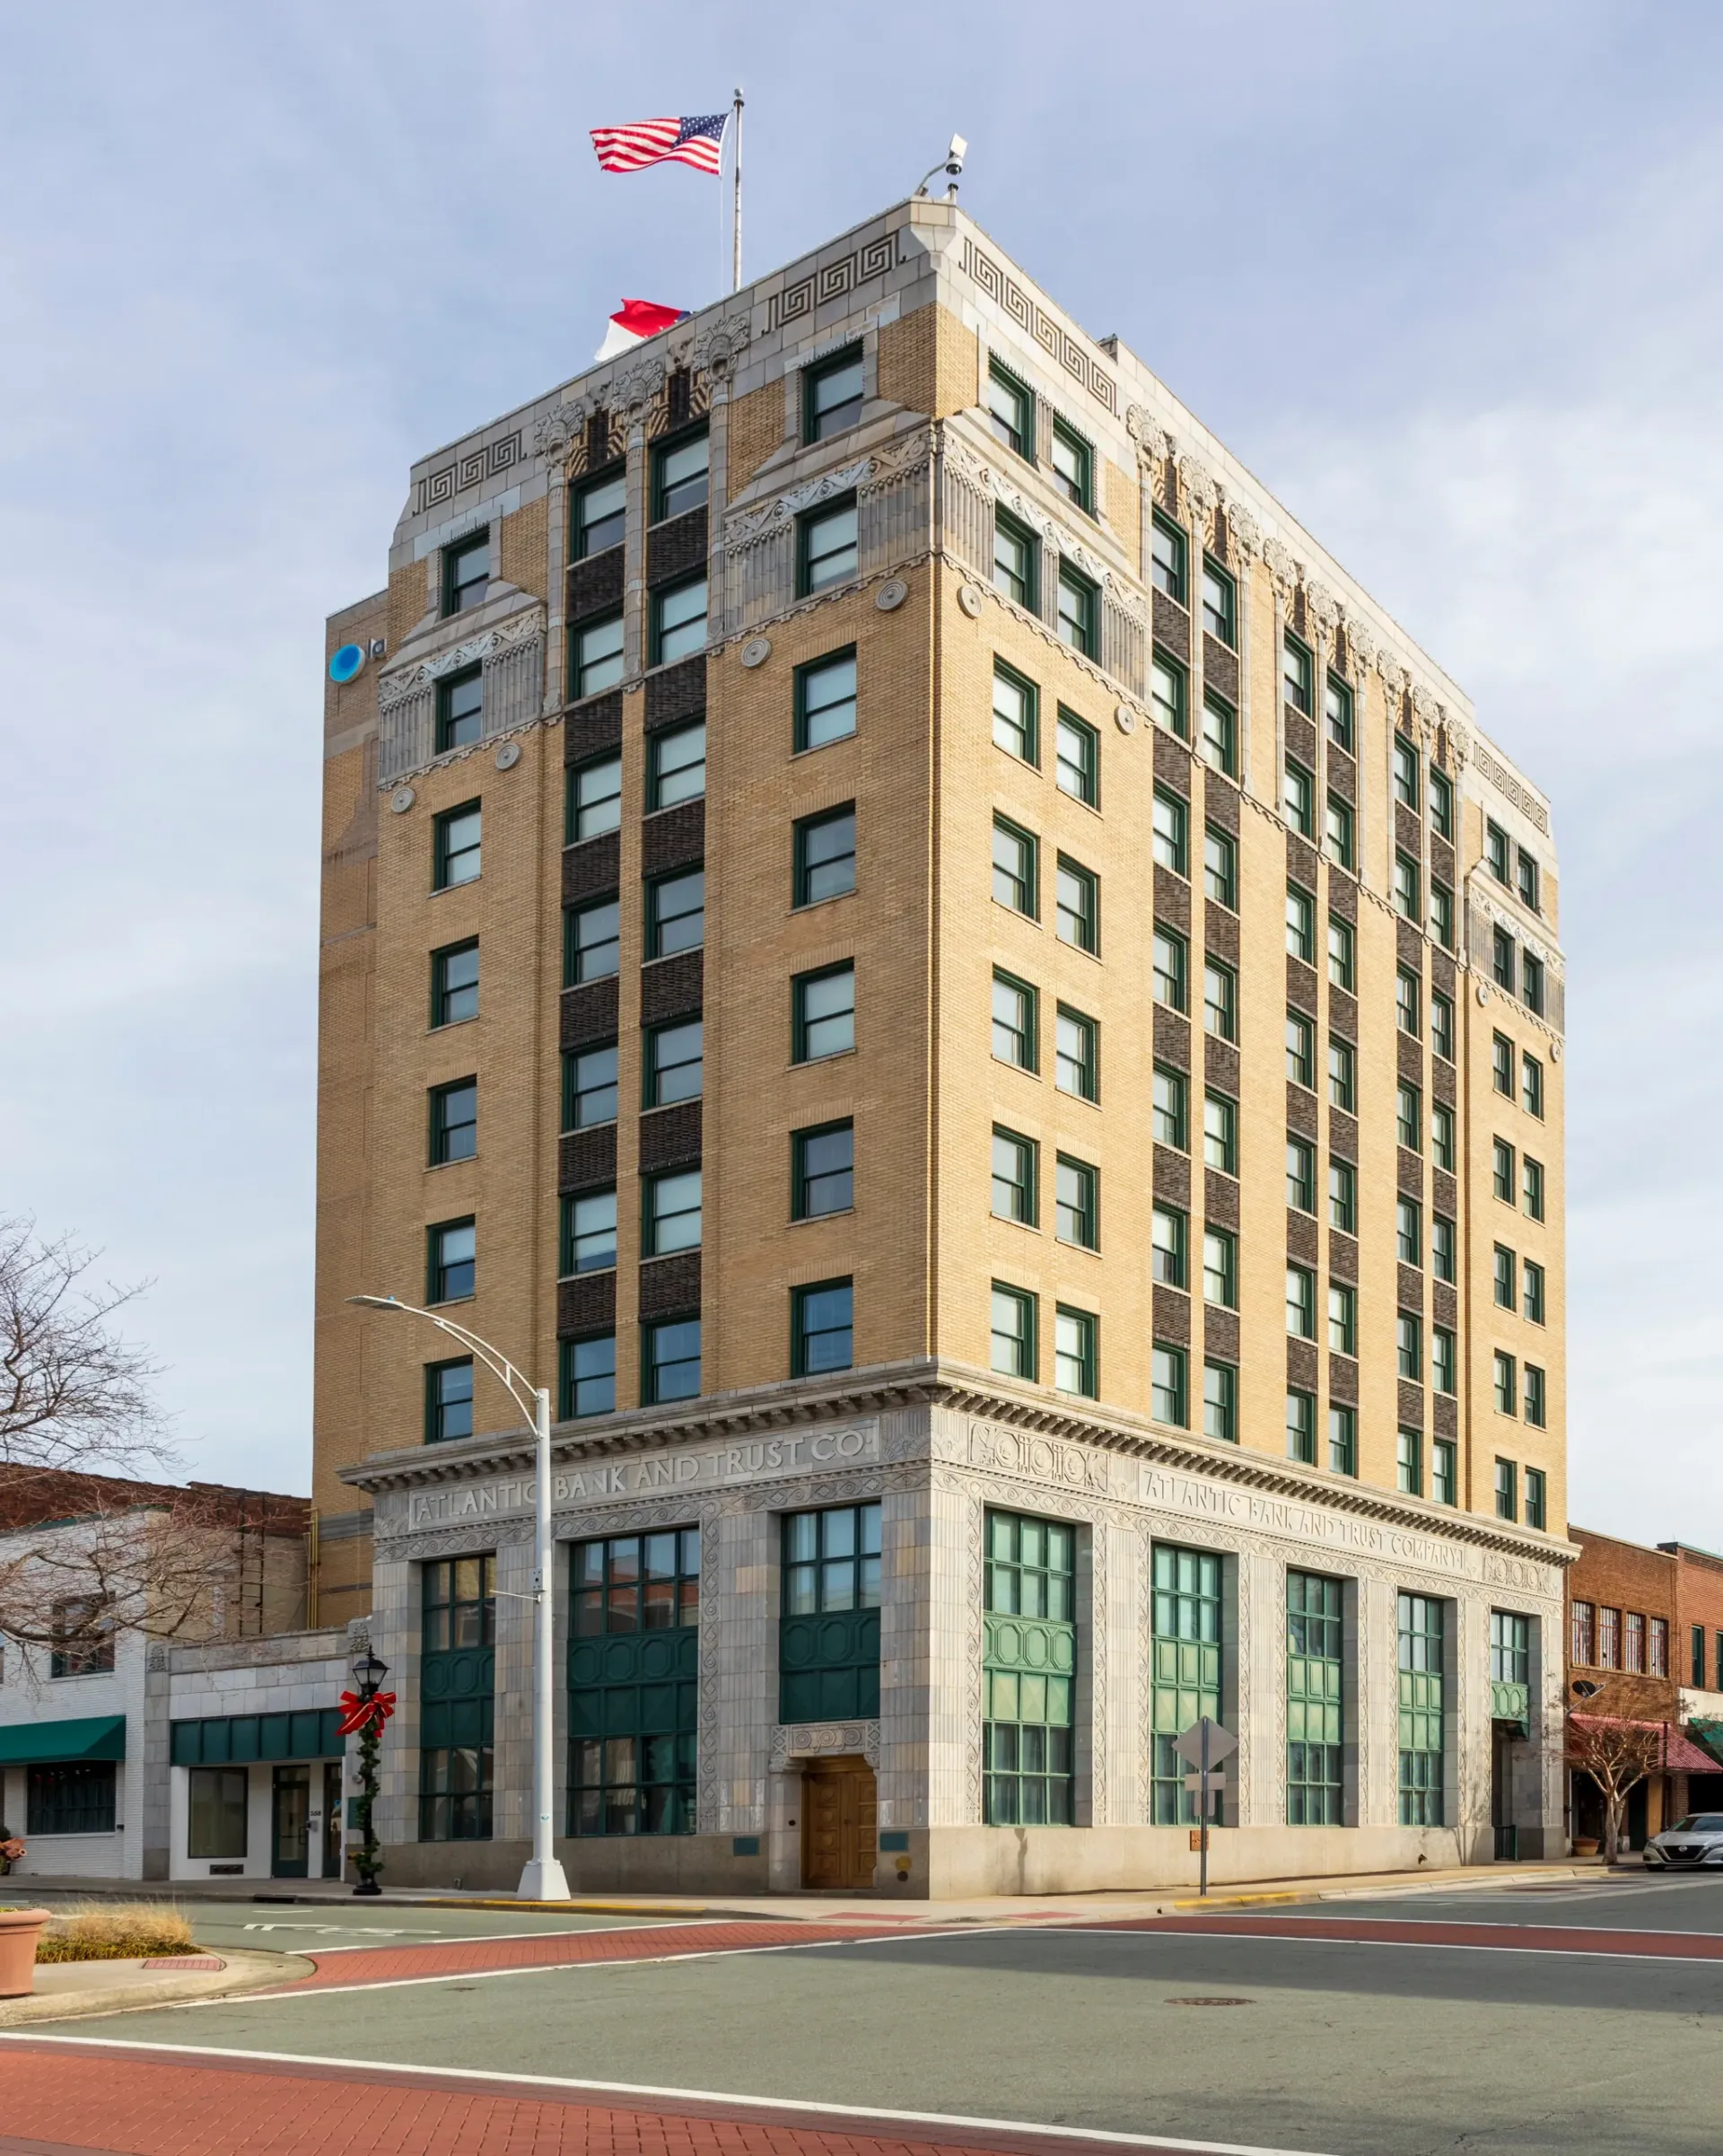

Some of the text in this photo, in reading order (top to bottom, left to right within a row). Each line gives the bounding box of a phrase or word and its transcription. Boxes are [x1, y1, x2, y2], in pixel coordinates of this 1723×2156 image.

[415, 1481, 537, 1523] ATLANTIC
[555, 1467, 626, 1500] BANK
[635, 1456, 699, 1488] AND
[706, 1436, 806, 1477] TRUST
[1146, 1471, 1241, 1516] ATLANTIC
[1249, 1496, 1293, 1529] BANK
[1299, 1510, 1334, 1538] AND
[1339, 1519, 1386, 1550] TRUST
